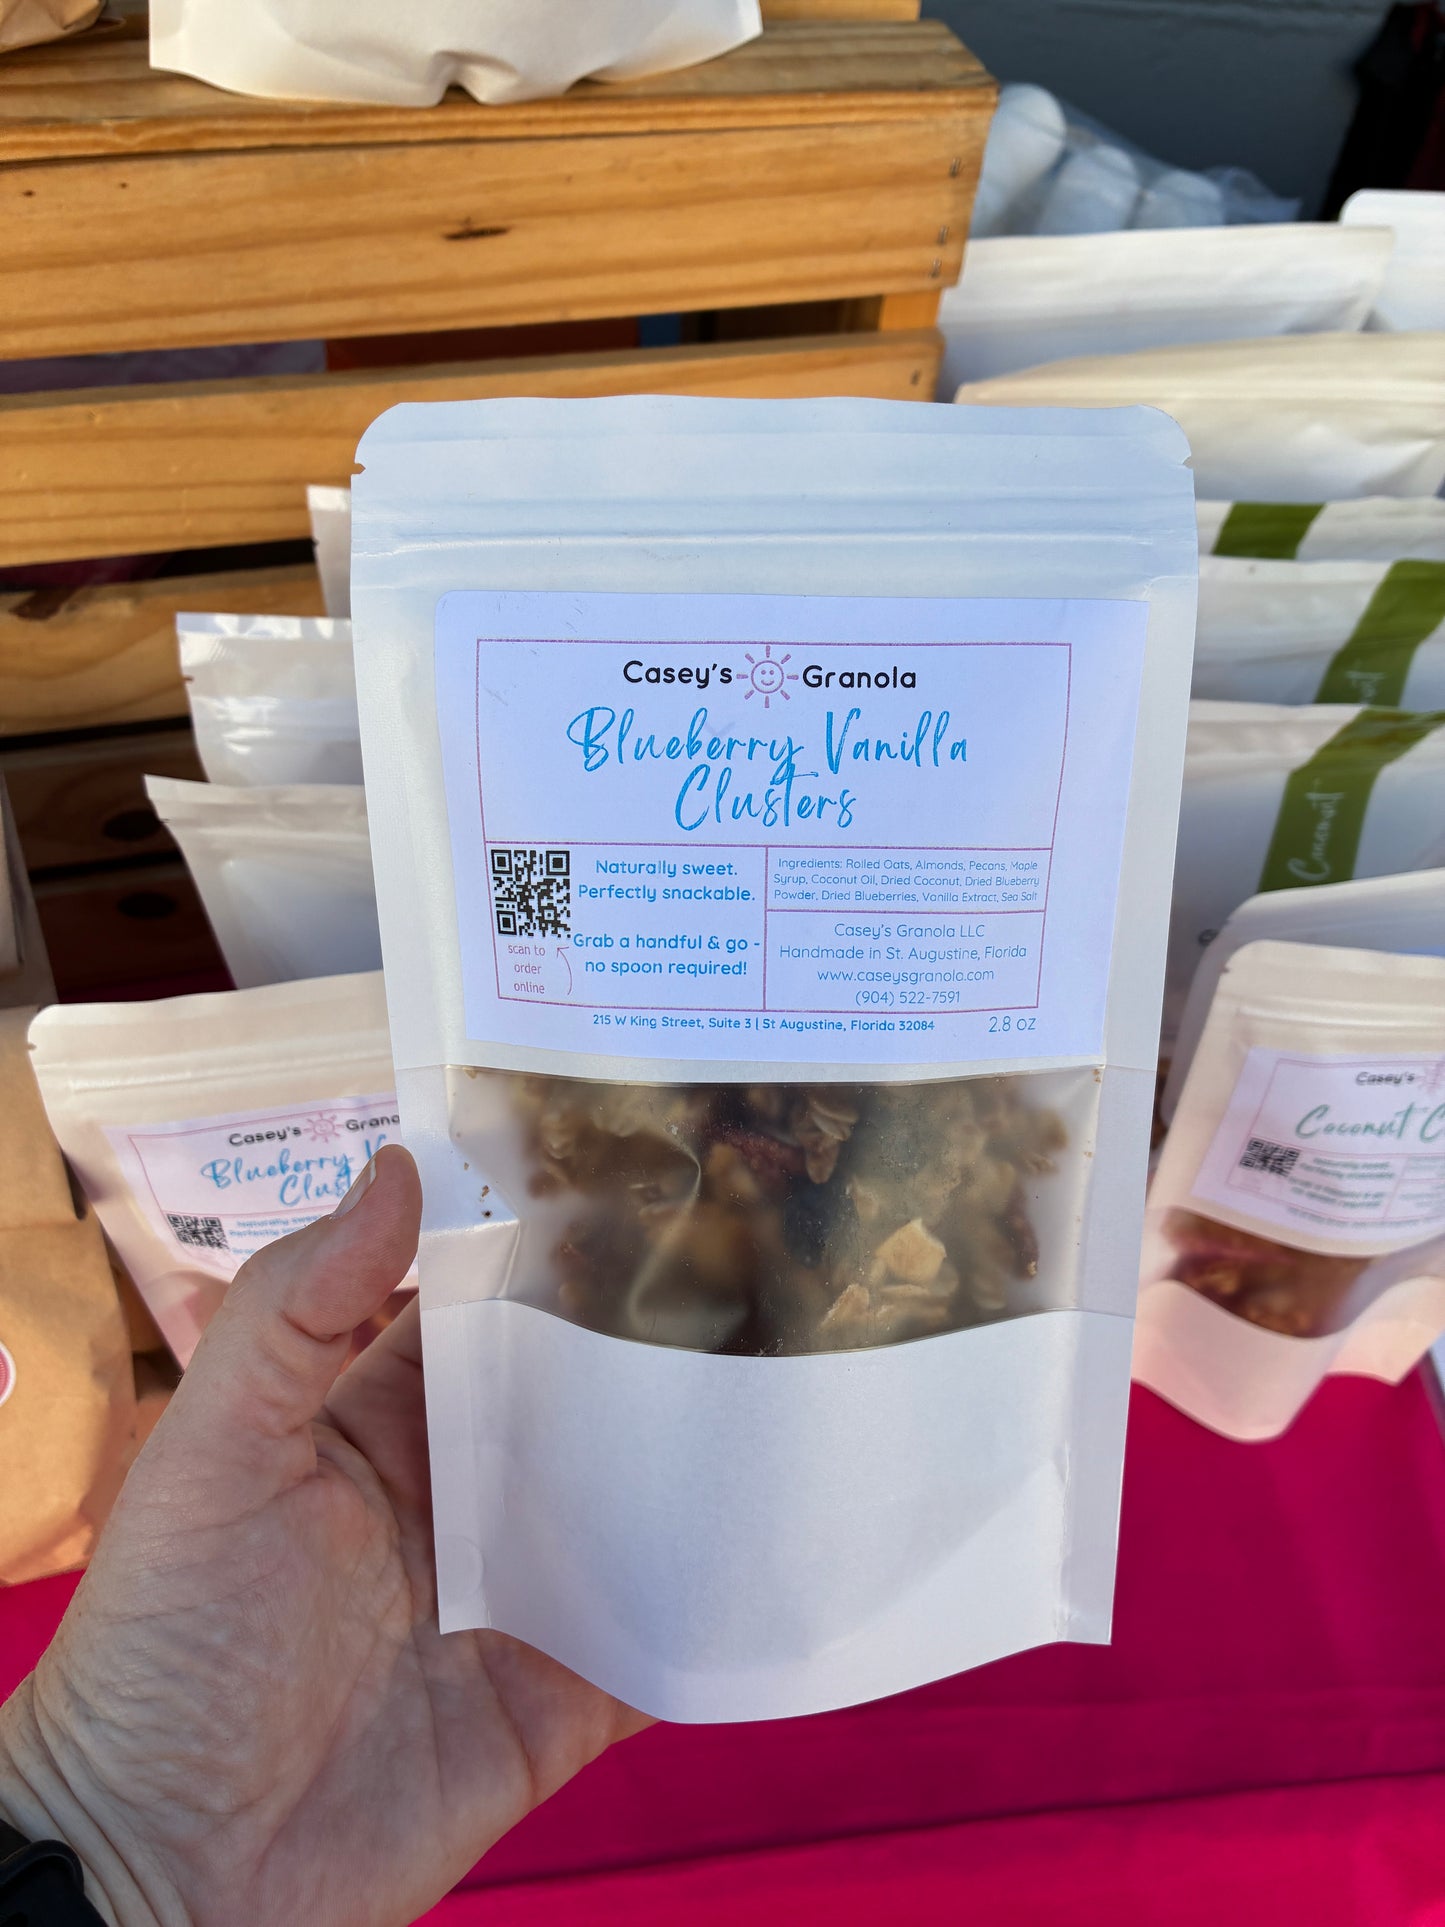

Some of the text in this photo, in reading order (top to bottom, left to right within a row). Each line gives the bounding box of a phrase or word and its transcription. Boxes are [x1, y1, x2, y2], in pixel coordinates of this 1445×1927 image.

[623, 660, 917, 689] Casey's Granola
[566, 706, 968, 785] Blueberry Vanilla
[674, 763, 857, 831] Clusters
[595, 860, 738, 877] Naturally sweet.
[778, 858, 1038, 872] Ingredients: Rolled Oats, Almonds, Pecans, Maple
[774, 873, 1039, 887] Syrup, Coconut Oil, Dried Coconut, Dried Blueberry
[578, 884, 755, 902] Perfectly snackable.
[774, 889, 1038, 903] Powder, Dried Blueberries, Vanilla Extract, Sea Salt
[834, 923, 985, 940] Casey's Granola LLC
[508, 943, 546, 956] scan to
[573, 933, 614, 948] Grab
[619, 937, 630, 948] a
[636, 935, 702, 949] handful
[707, 936, 720, 949] &
[726, 938, 749, 953] go
[780, 945, 1027, 963] Handmade in St. Augustine, Florida
[514, 963, 542, 974] order
[585, 961, 747, 977] no spoon required!
[817, 969, 994, 984] www.caseysgranola.com
[513, 981, 546, 994] online
[855, 991, 960, 1006] (904) 522-7591
[593, 1015, 611, 1025] 215
[615, 1016, 627, 1026] W
[630, 1015, 657, 1029] King
[661, 1017, 705, 1029] Street,
[709, 1018, 741, 1028] Suite
[745, 1018, 752, 1029] 3
[762, 1019, 776, 1029] St
[779, 1019, 847, 1031] Augustine,
[851, 1020, 895, 1031] Florida
[899, 1020, 935, 1031] 32084
[988, 1016, 1036, 1033] 2.8 oz
[1295, 1102, 1429, 1139] Coconut
[228, 1114, 400, 1147] Casey's Grano
[201, 1148, 354, 1189] Blueberry
[279, 1169, 355, 1207] Clust
